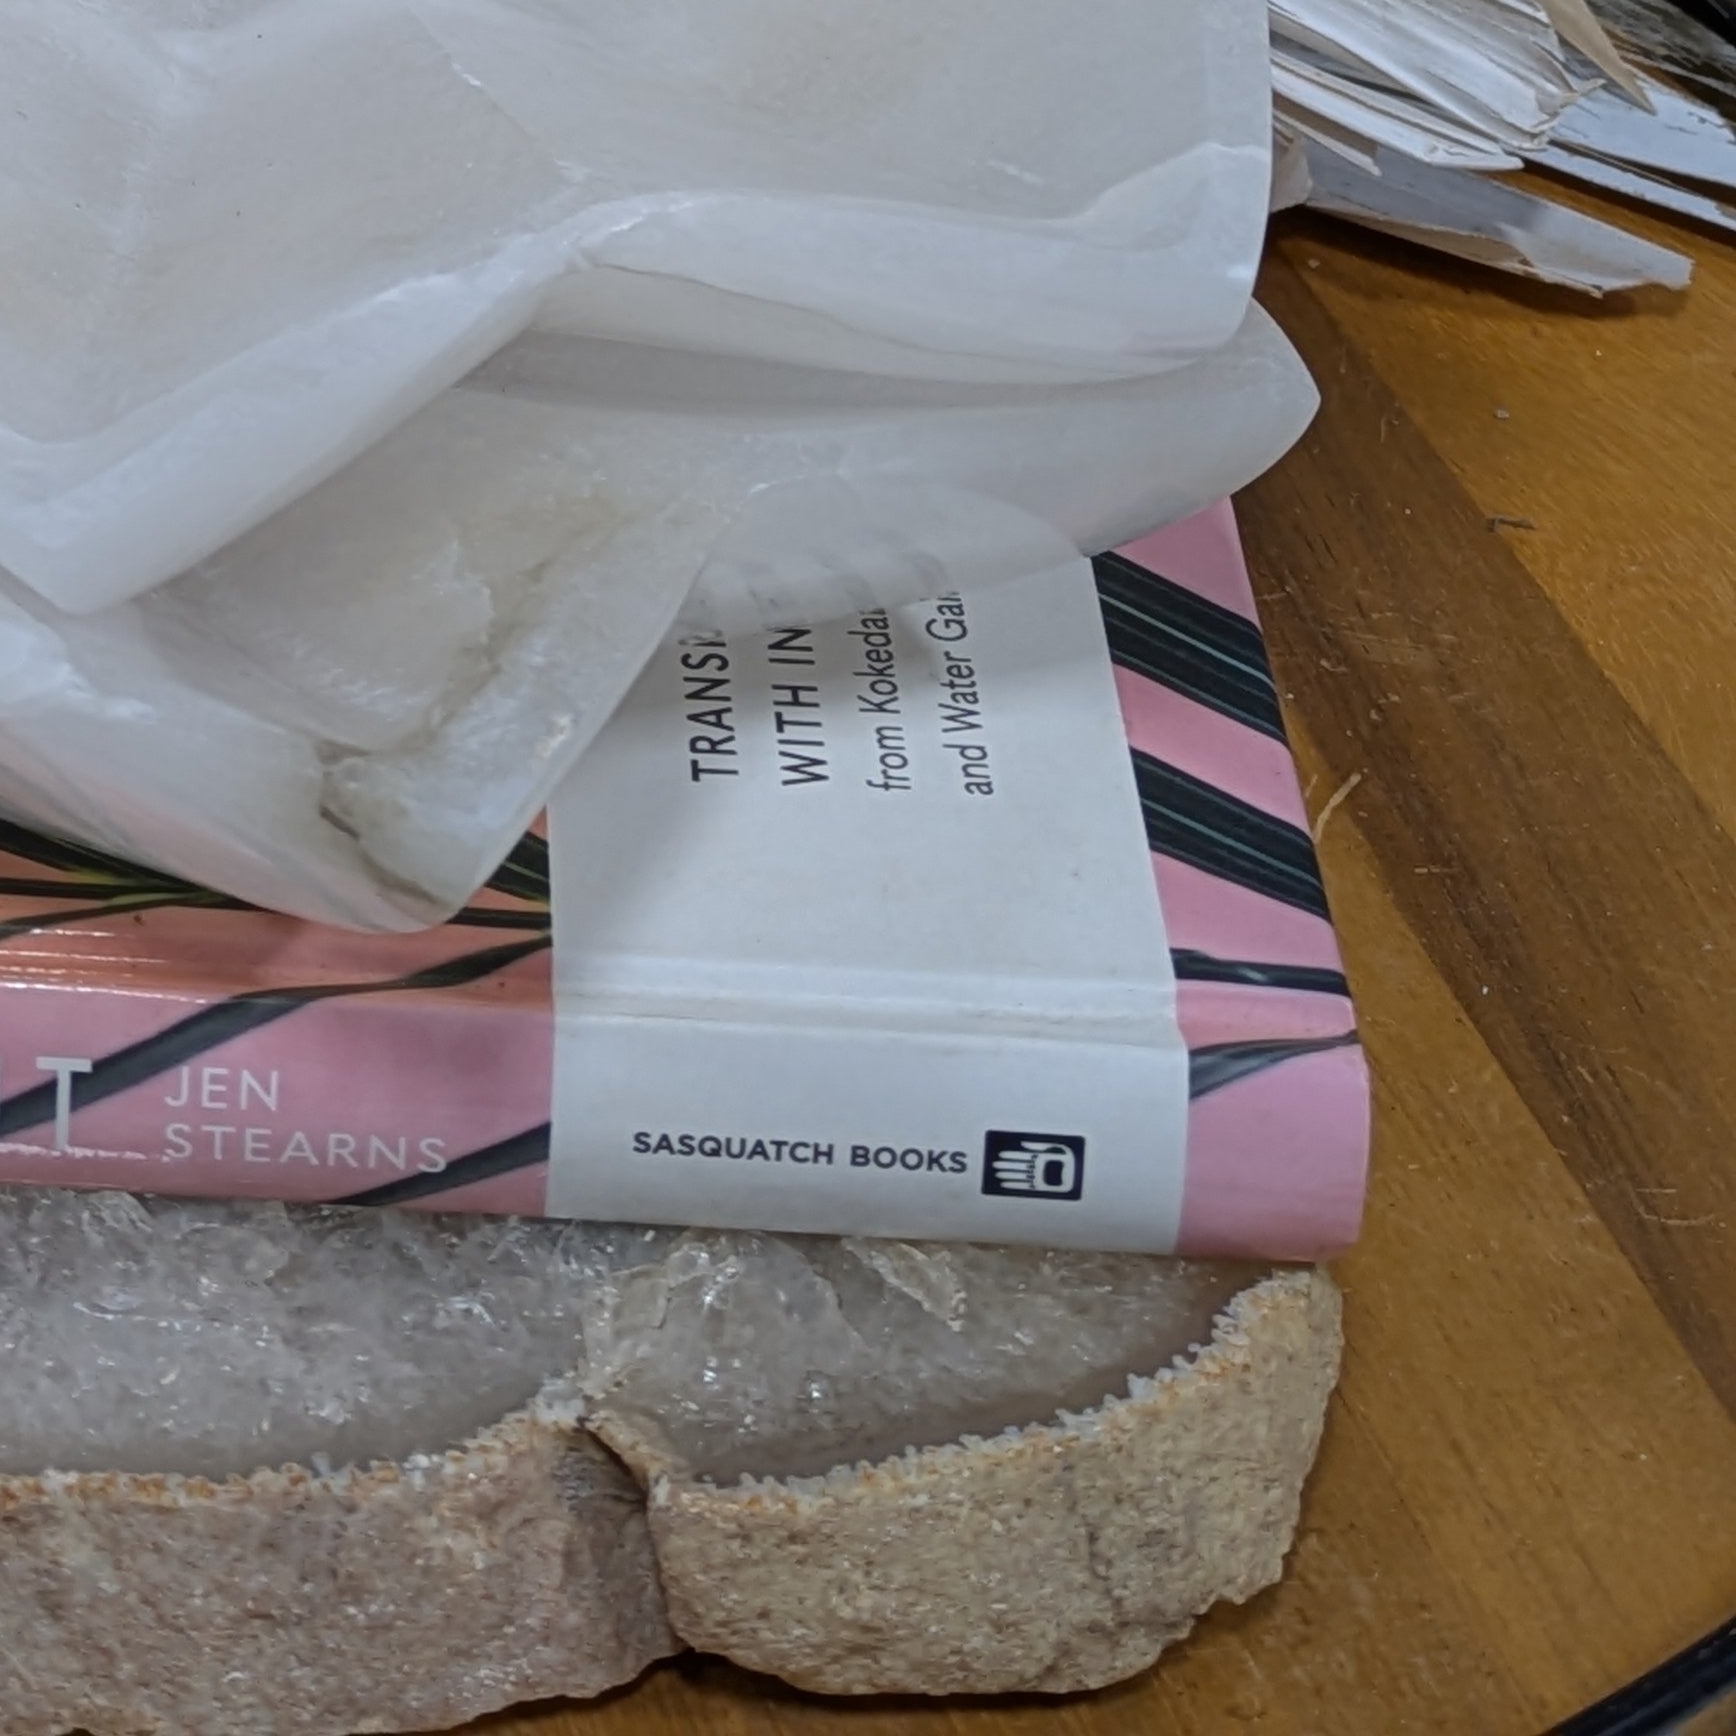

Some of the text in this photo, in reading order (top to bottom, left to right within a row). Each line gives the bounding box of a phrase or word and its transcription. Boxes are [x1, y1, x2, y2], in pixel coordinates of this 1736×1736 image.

[938, 651, 983, 733] Water
[771, 684, 830, 786] WITH
[866, 725, 912, 791] from
[943, 744, 994, 796] and
[164, 1066, 280, 1113] JEN
[163, 1122, 448, 1175] STEARNS
[632, 1130, 968, 1175] SASQUATCH BOOKS
